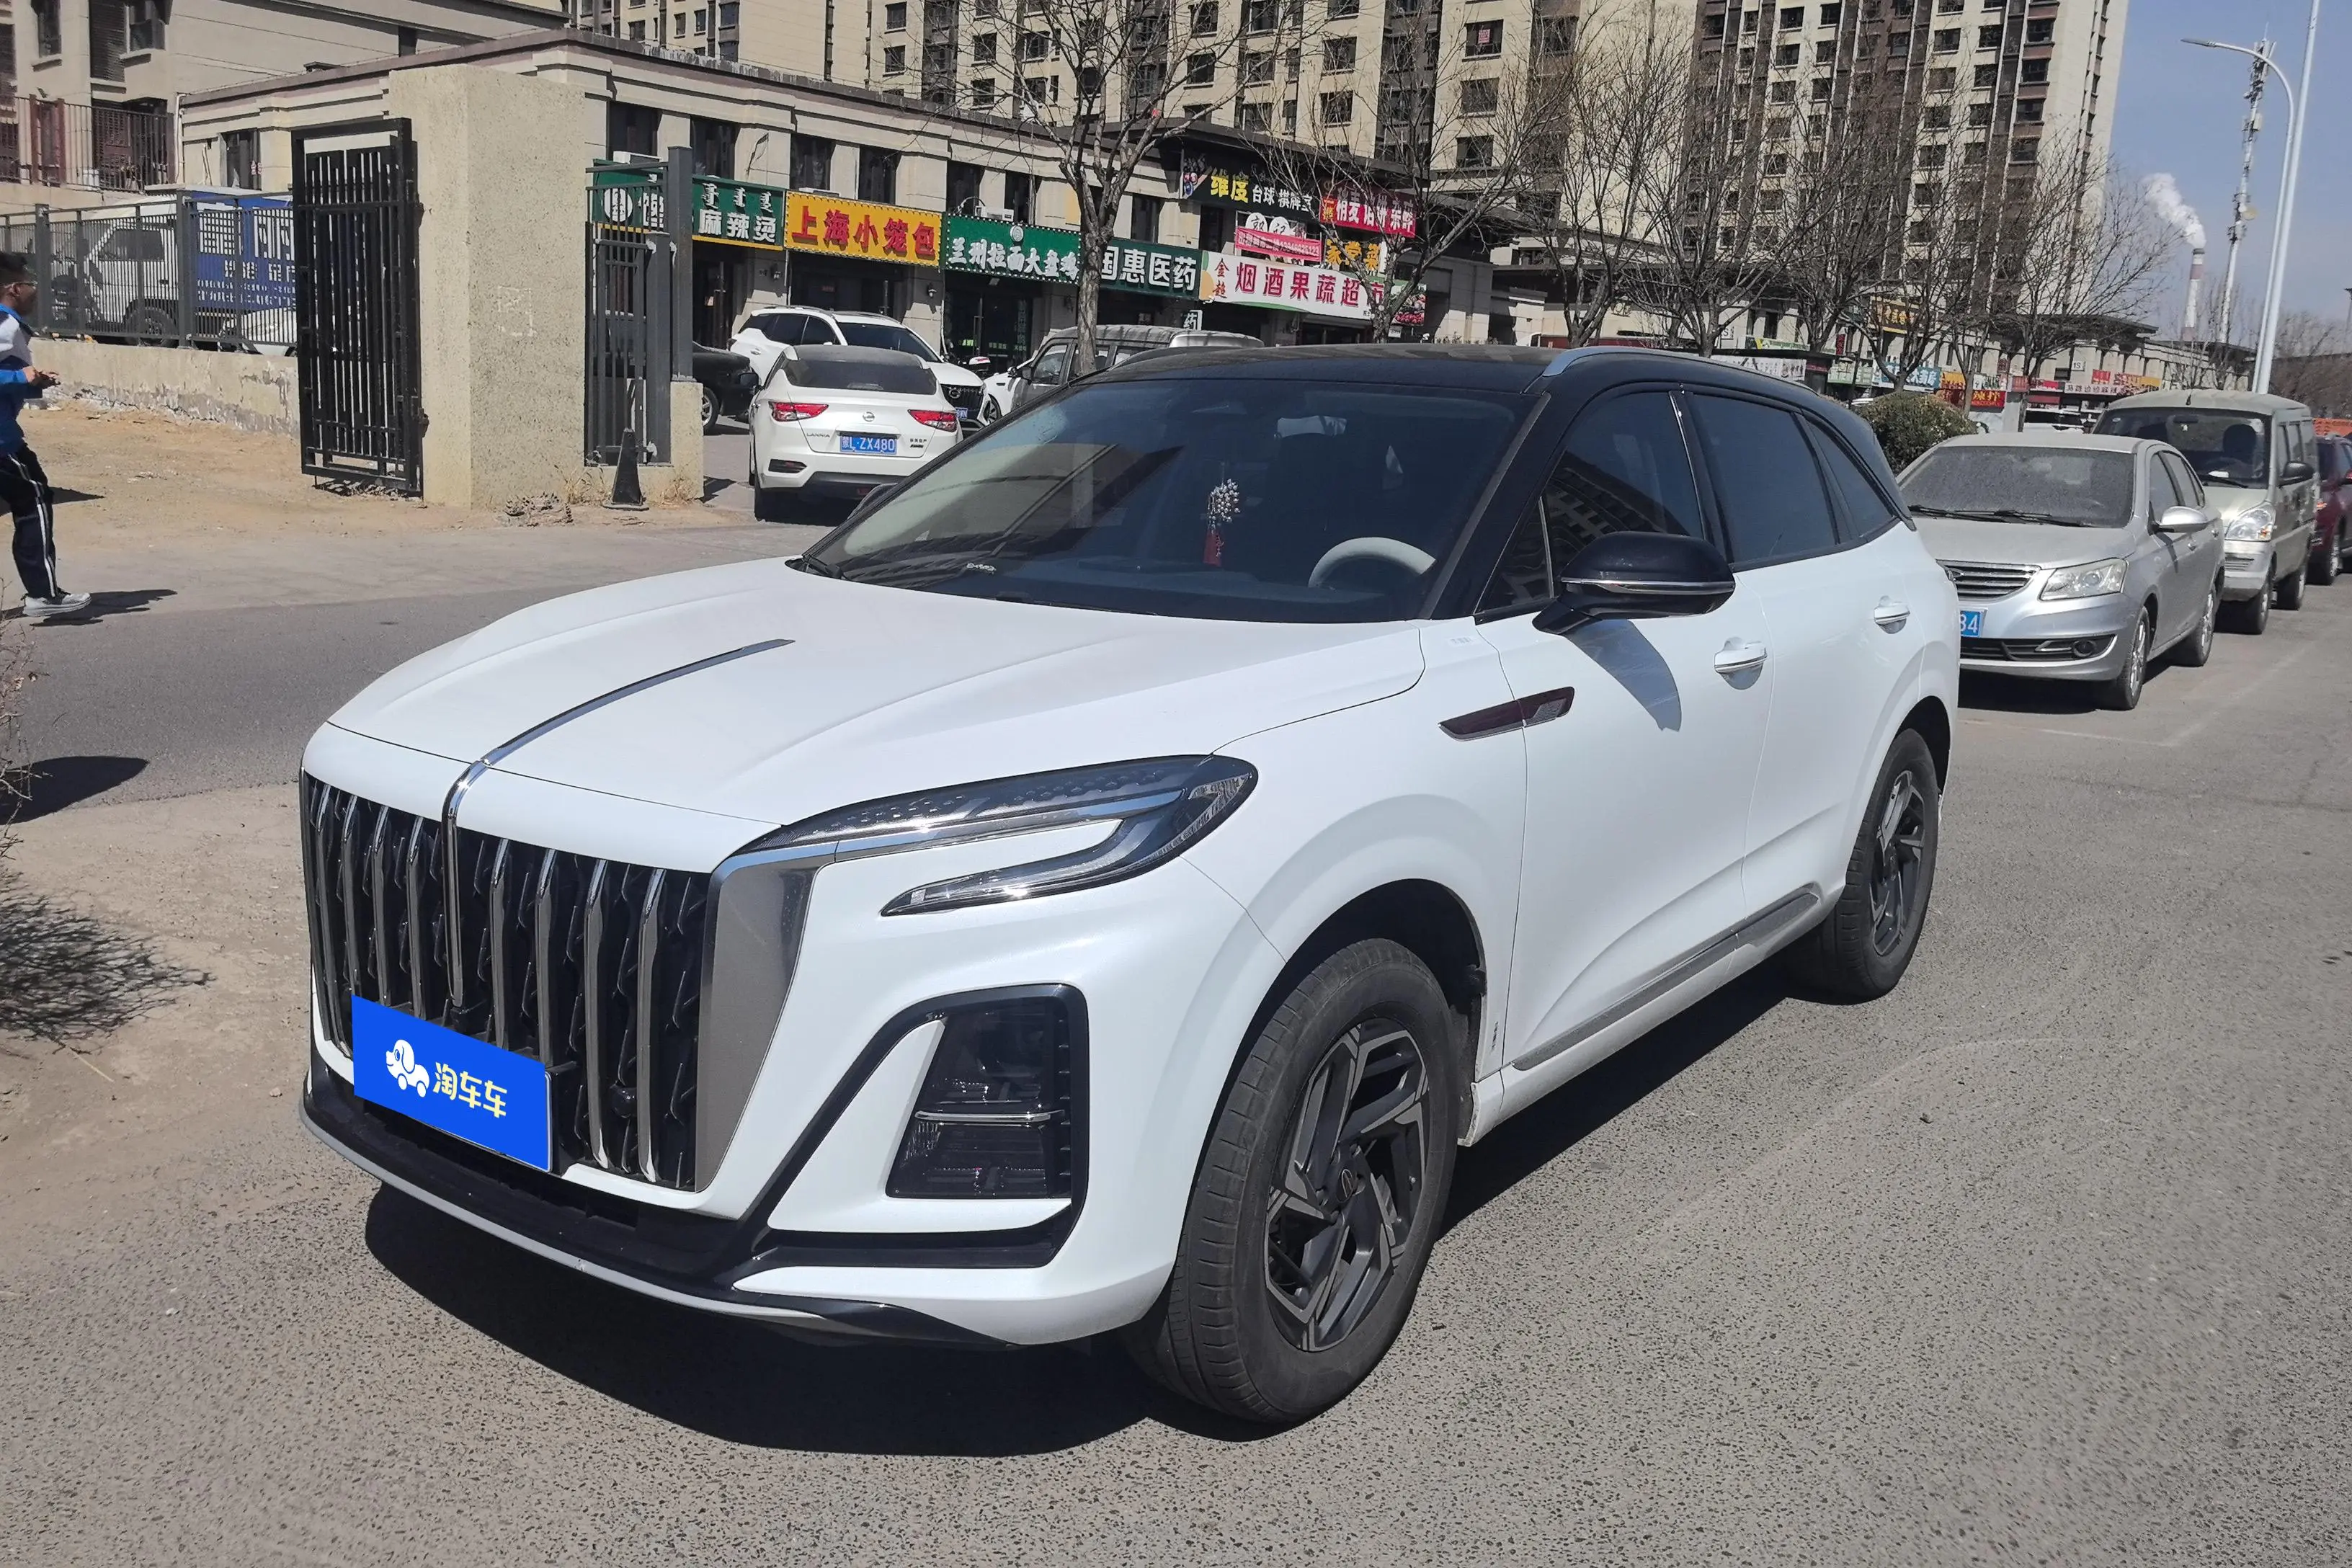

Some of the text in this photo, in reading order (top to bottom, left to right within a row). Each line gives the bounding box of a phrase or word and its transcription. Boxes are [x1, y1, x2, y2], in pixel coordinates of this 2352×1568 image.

[1211, 168, 1249, 203] 维度
[1252, 185, 1275, 205] 台球
[792, 205, 935, 260] 上海小笼包
[948, 237, 1079, 280] 兰州拉面大盘鸡
[1235, 262, 1384, 308] 烟酒果蔬超市
